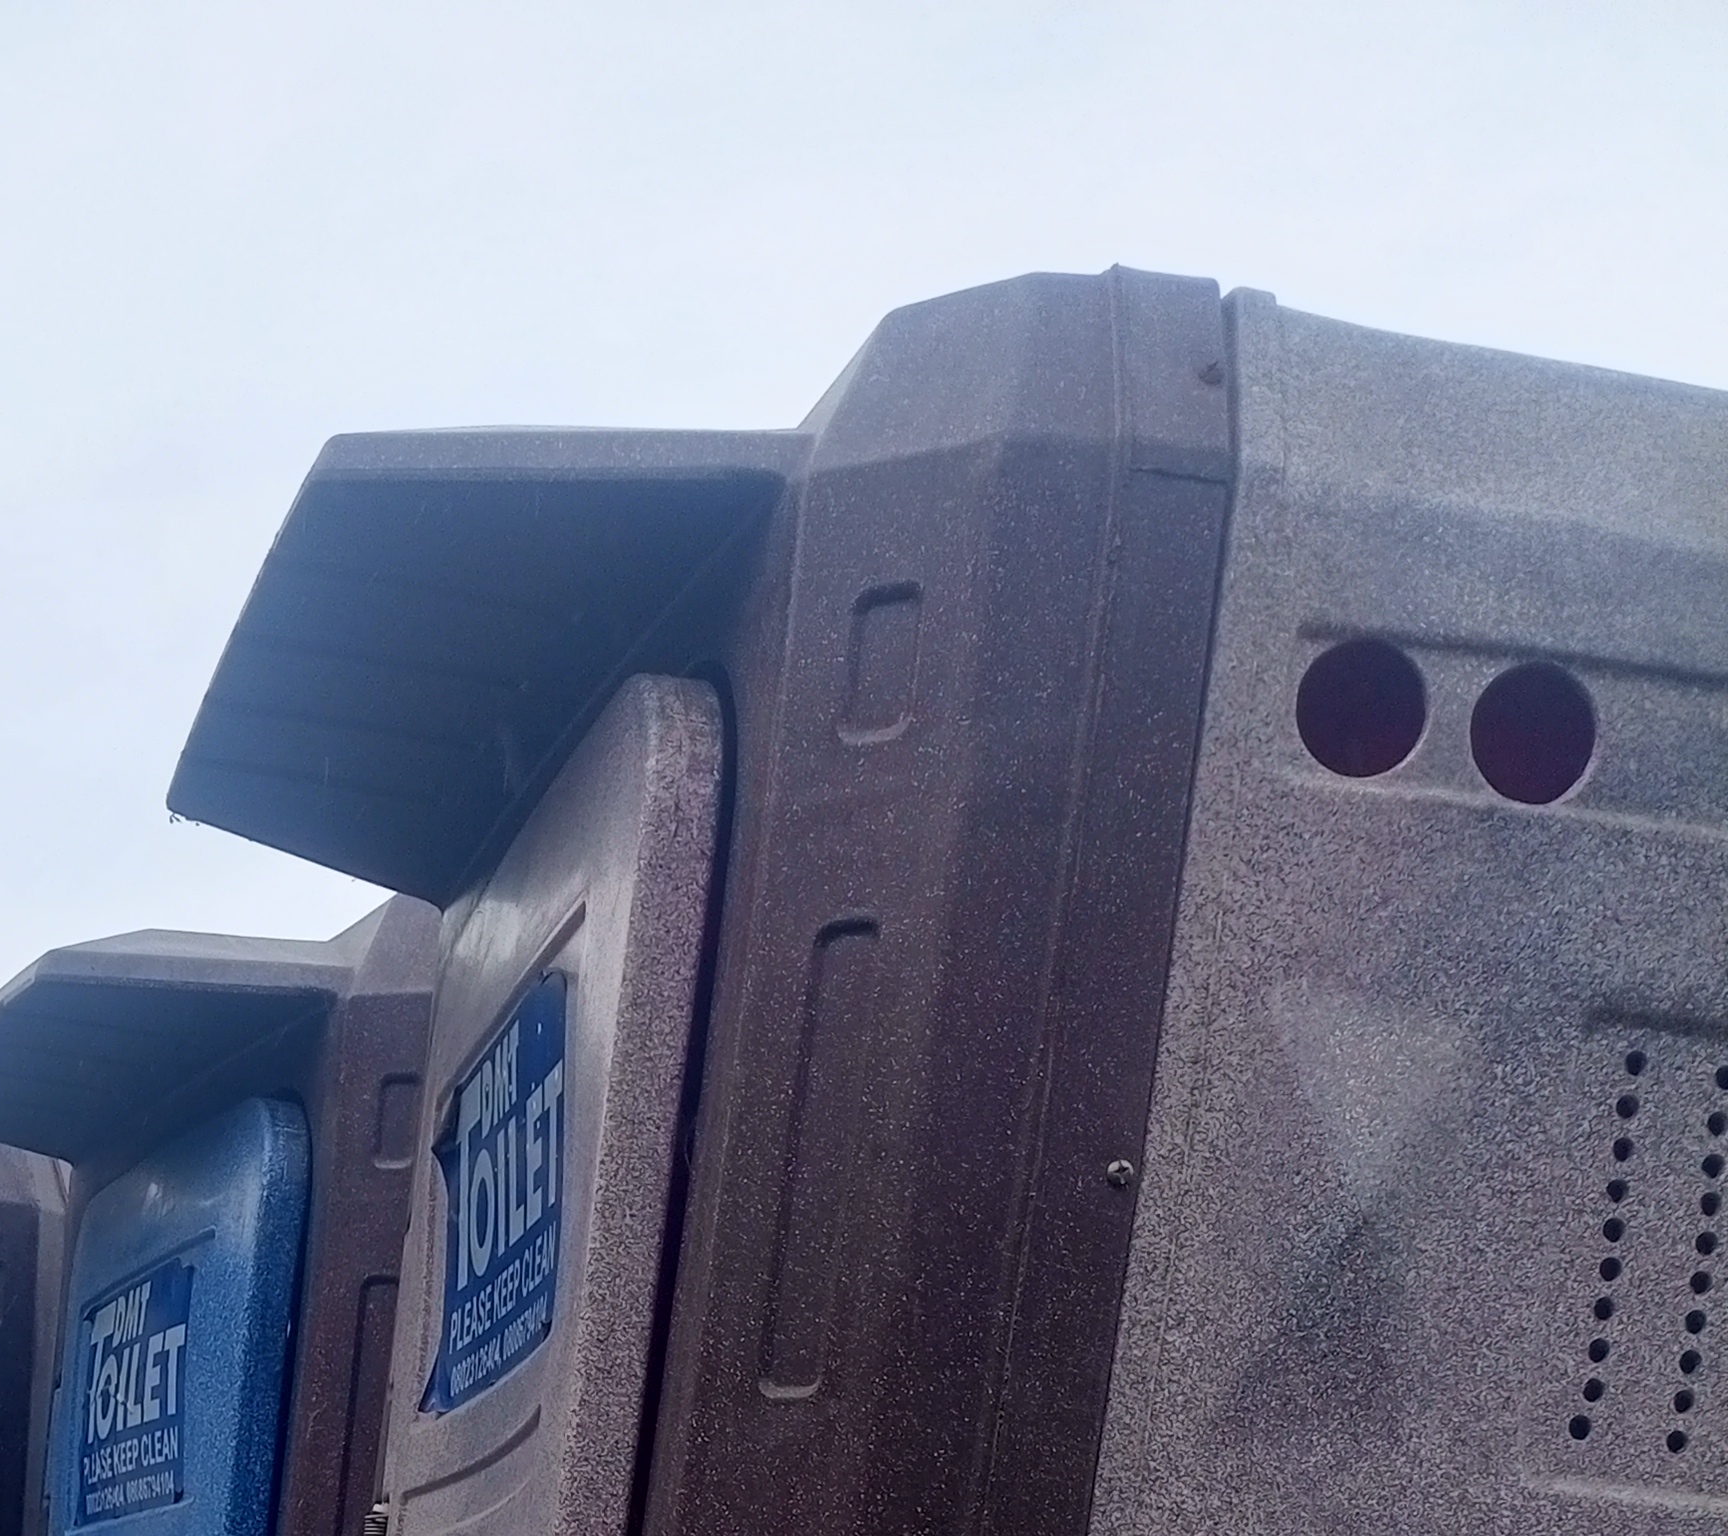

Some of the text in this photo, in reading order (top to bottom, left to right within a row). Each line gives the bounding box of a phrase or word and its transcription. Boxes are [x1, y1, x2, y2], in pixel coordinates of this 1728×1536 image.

[481, 1019, 520, 1140] DMT
[456, 1058, 563, 1292] TOILET
[112, 1280, 152, 1349] DMT
[448, 1220, 557, 1355] PLEASE KEEP CLEAN
[87, 1299, 186, 1444] TOILET
[113, 1438, 139, 1475] KEEP
[140, 1425, 179, 1467] CLEAN
